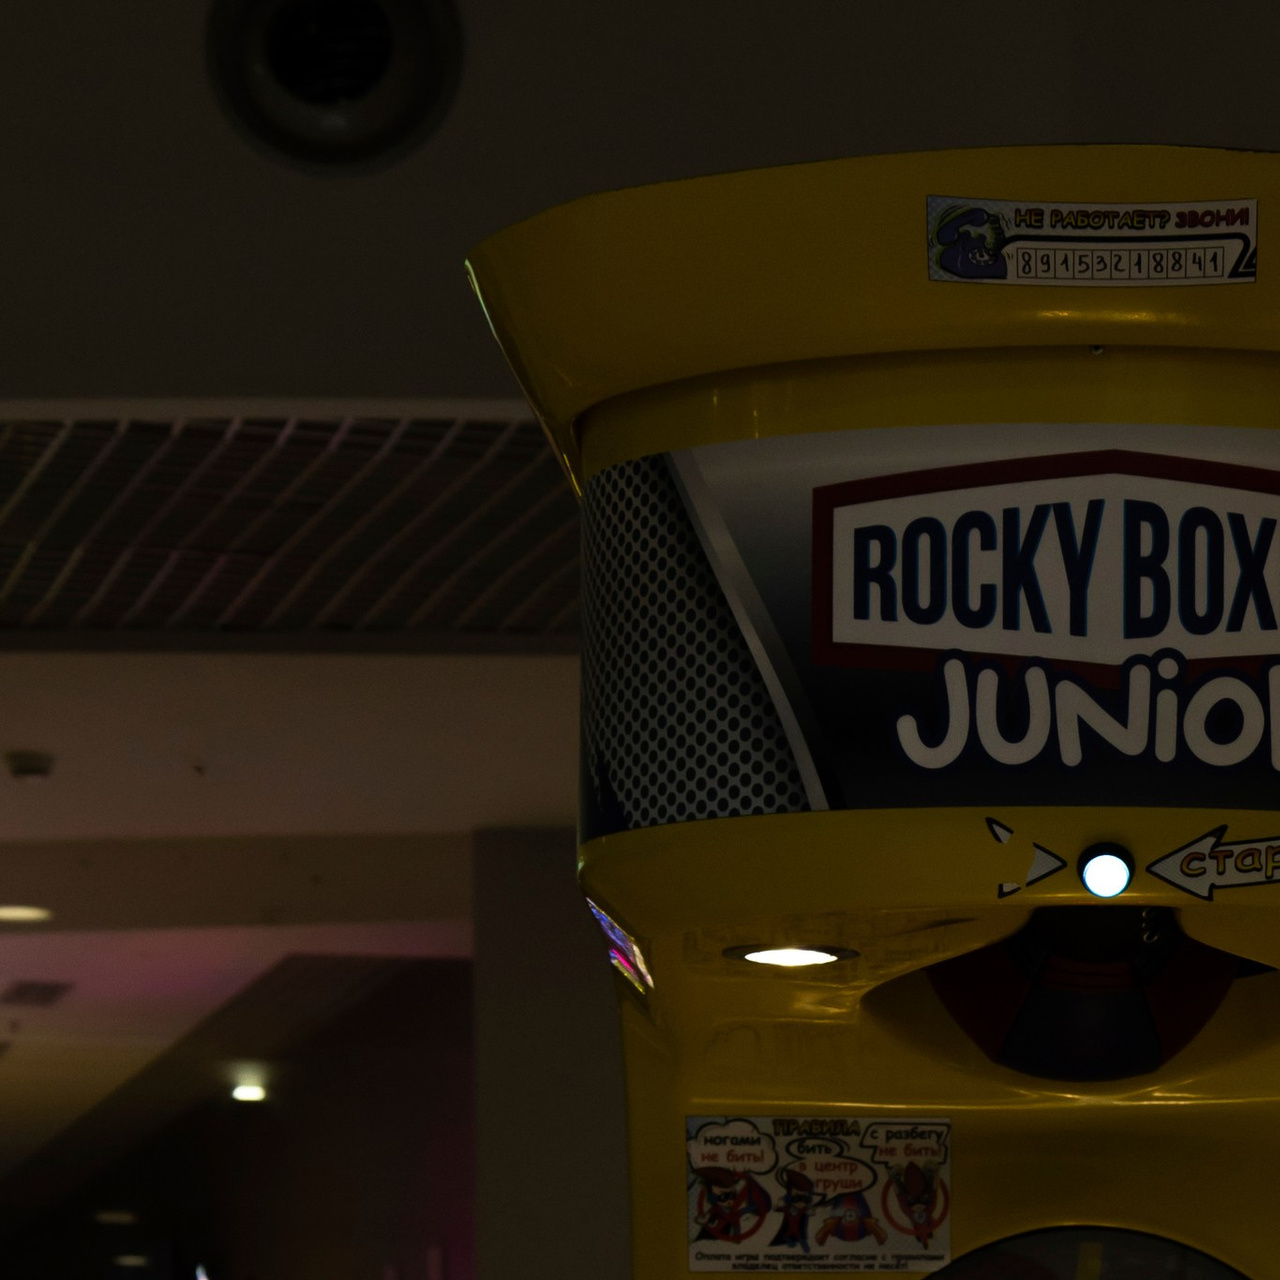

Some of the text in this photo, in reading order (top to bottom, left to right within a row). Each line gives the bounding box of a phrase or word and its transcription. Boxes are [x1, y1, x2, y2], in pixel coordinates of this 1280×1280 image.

[1014, 207, 1249, 230] НЕ РАБОТАЕТ? ЗВОНИ!
[853, 499, 1105, 638] ROCKY
[773, 1118, 861, 1137] ПРАВИЛА
[704, 1135, 761, 1146] ногами
[870, 1127, 945, 1144] с разбегу
[797, 1142, 833, 1155] бить
[878, 1145, 898, 1157] не
[701, 1151, 765, 1163] не бить!
[814, 1161, 859, 1174] центр
[815, 1178, 863, 1191] груши
